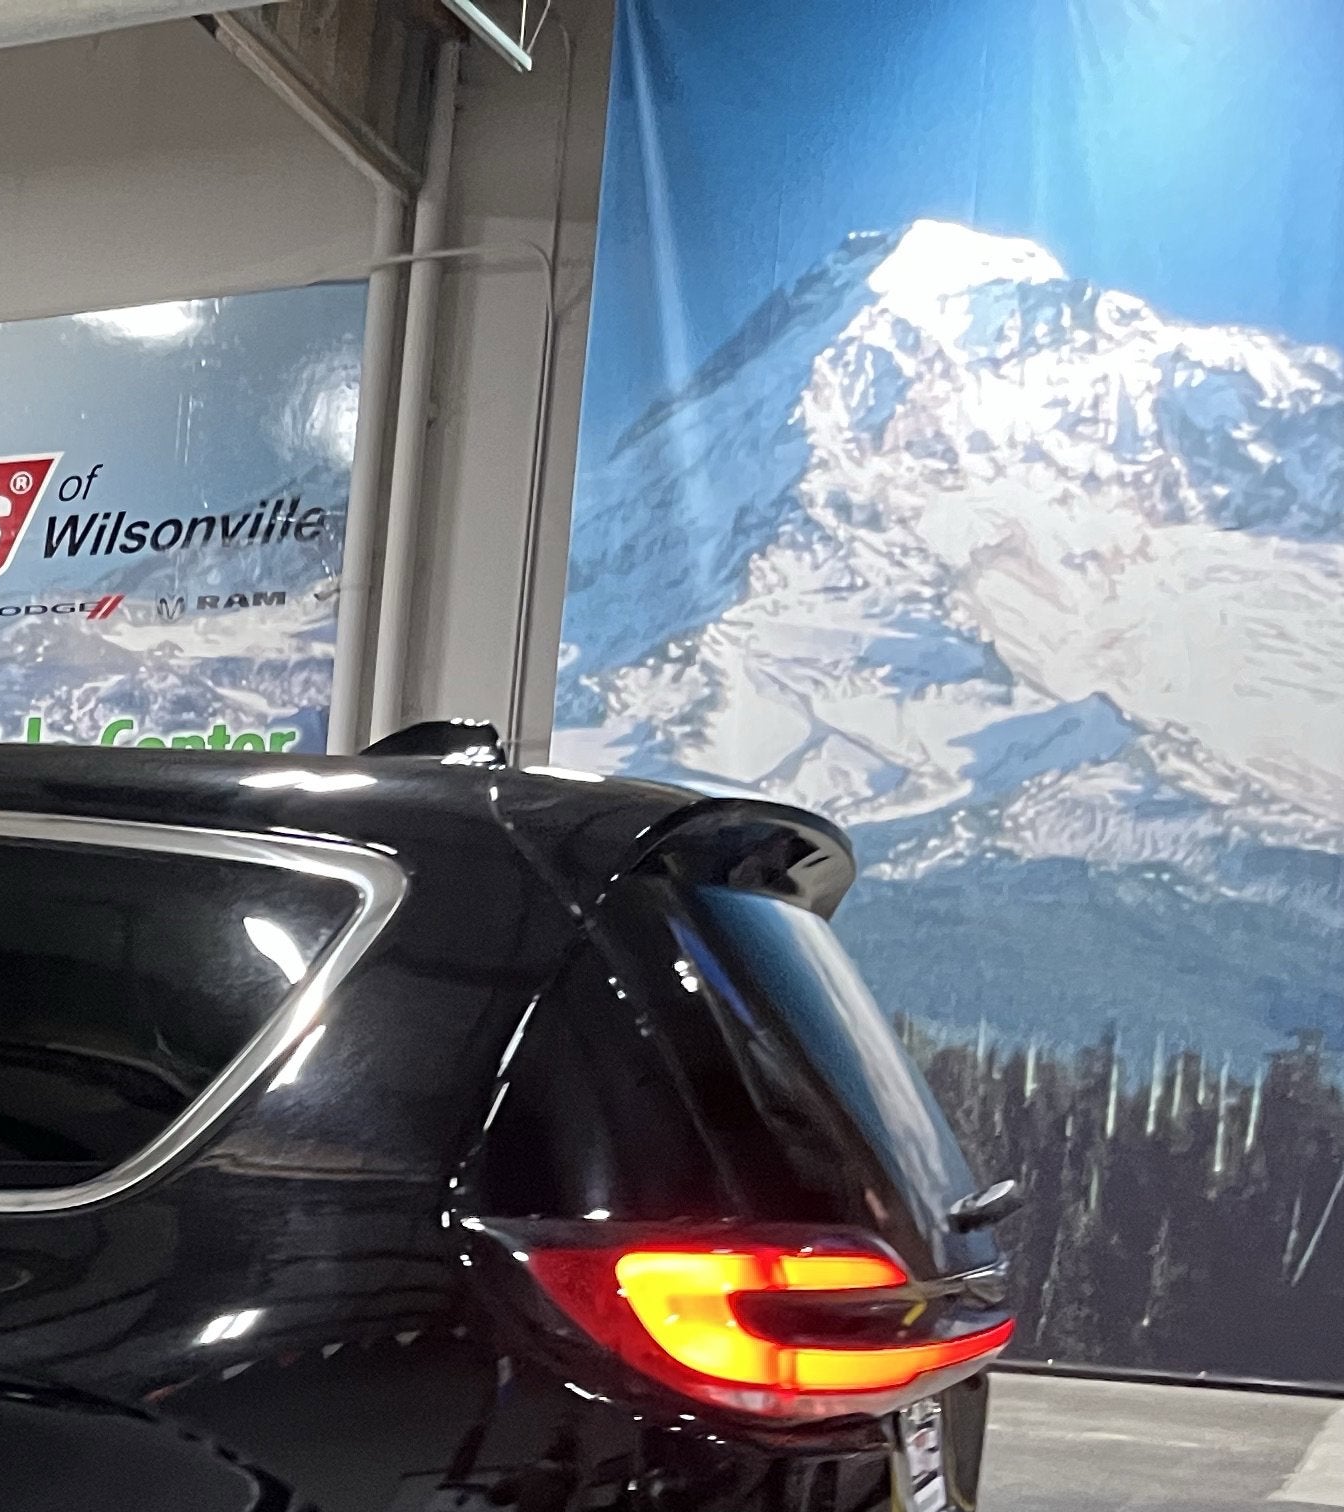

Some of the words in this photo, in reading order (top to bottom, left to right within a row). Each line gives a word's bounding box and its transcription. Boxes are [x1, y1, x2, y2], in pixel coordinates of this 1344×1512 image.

[58, 464, 104, 502] of
[43, 496, 326, 559] Wilsonville
[196, 591, 287, 610] RAM
